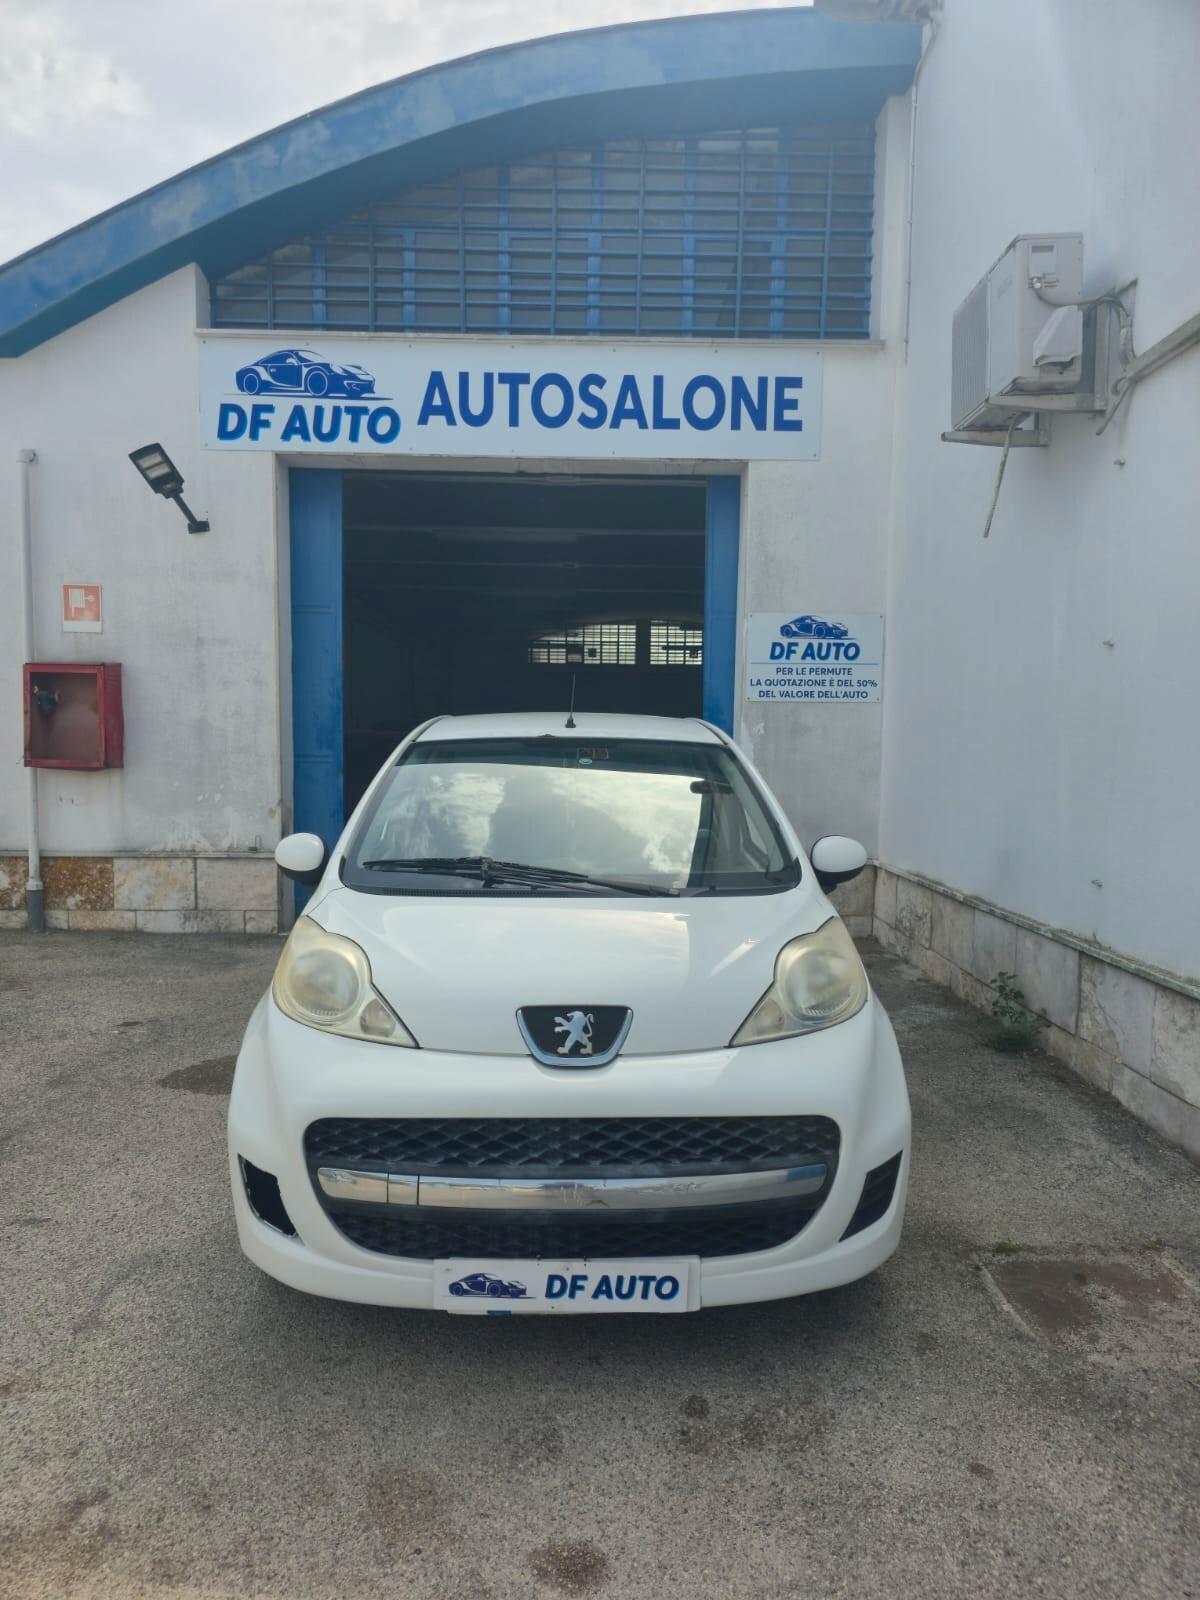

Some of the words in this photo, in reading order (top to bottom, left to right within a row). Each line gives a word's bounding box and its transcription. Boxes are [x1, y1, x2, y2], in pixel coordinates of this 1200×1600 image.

[417, 370, 804, 432] AUTOSALONE
[216, 402, 275, 442] DF
[280, 404, 402, 445] AUTO
[769, 642, 799, 660] DF
[801, 642, 861, 661] AUTO
[776, 667, 793, 675] PER
[764, 679, 826, 687] QUOTAZIONE
[837, 679, 854, 687] DEL
[759, 690, 776, 698] DEL
[817, 691, 868, 699] DELL'AUTO
[544, 1274, 589, 1299] DF
[591, 1275, 680, 1300] AUTO
